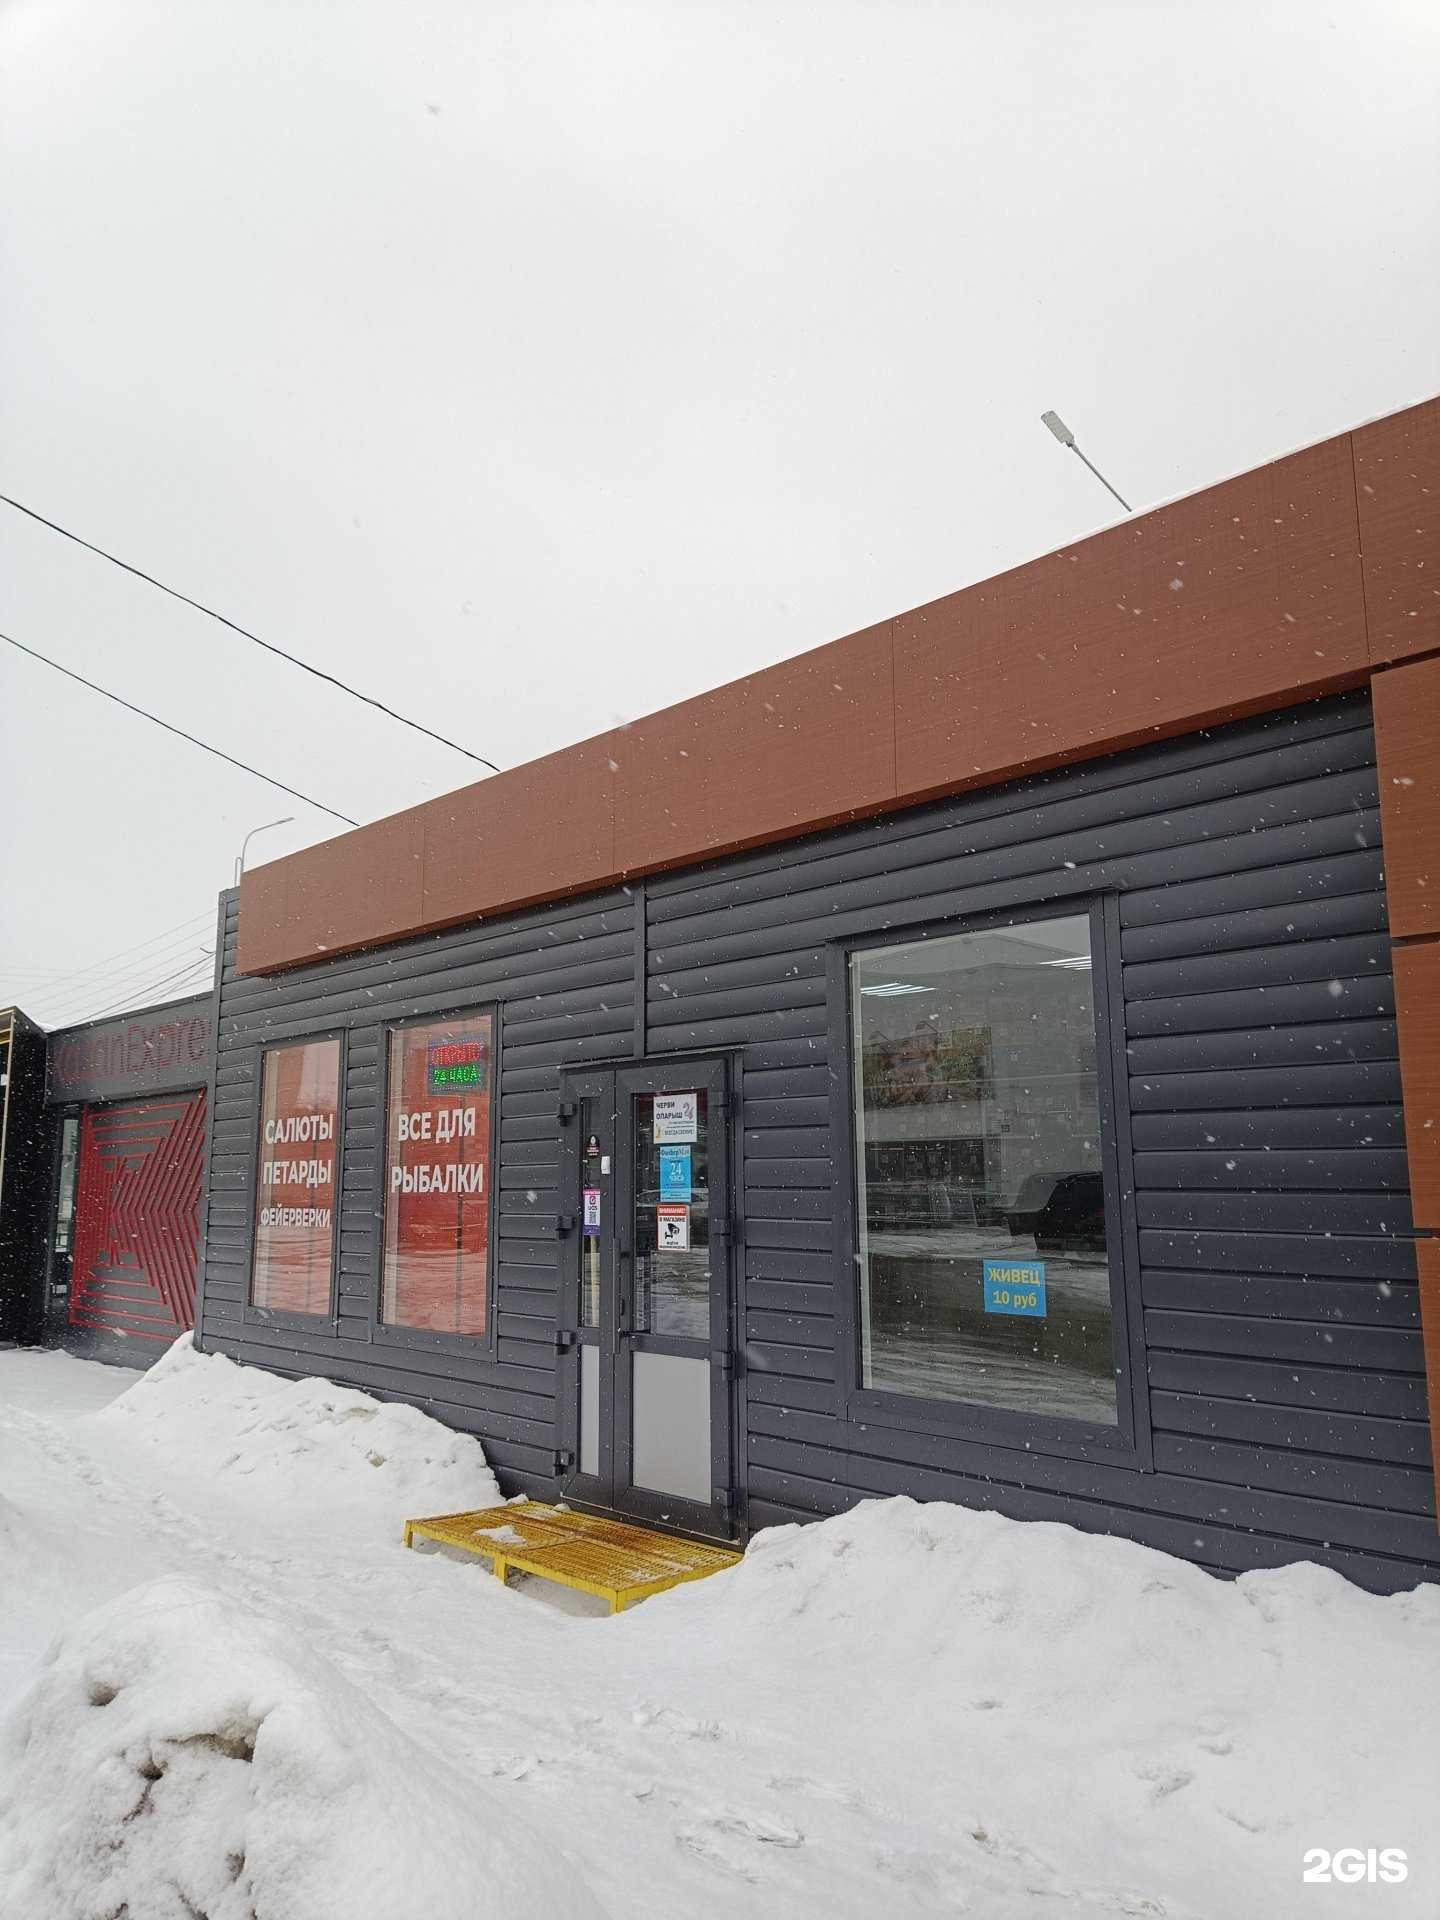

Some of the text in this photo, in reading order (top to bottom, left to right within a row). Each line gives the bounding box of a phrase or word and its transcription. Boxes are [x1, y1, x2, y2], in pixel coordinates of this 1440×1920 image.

[433, 1069, 447, 1085] 24
[656, 1101, 675, 1109] ЧЕРВИ
[399, 1107, 476, 1144] ВСЕ ДЛЯ
[656, 1112, 683, 1120] ОПАРЫШ
[265, 1114, 334, 1144] САЛЮТЫ
[263, 1160, 332, 1188] ПЕТАРДЫ
[391, 1163, 483, 1193] РЫБАЛКИ
[671, 1162, 682, 1175] 24
[260, 1203, 331, 1228] ФЕЙЕРВЕРКИ
[988, 1268, 1041, 1287] ЖИВЕЦ
[993, 1290, 1037, 1309] 10 руб
